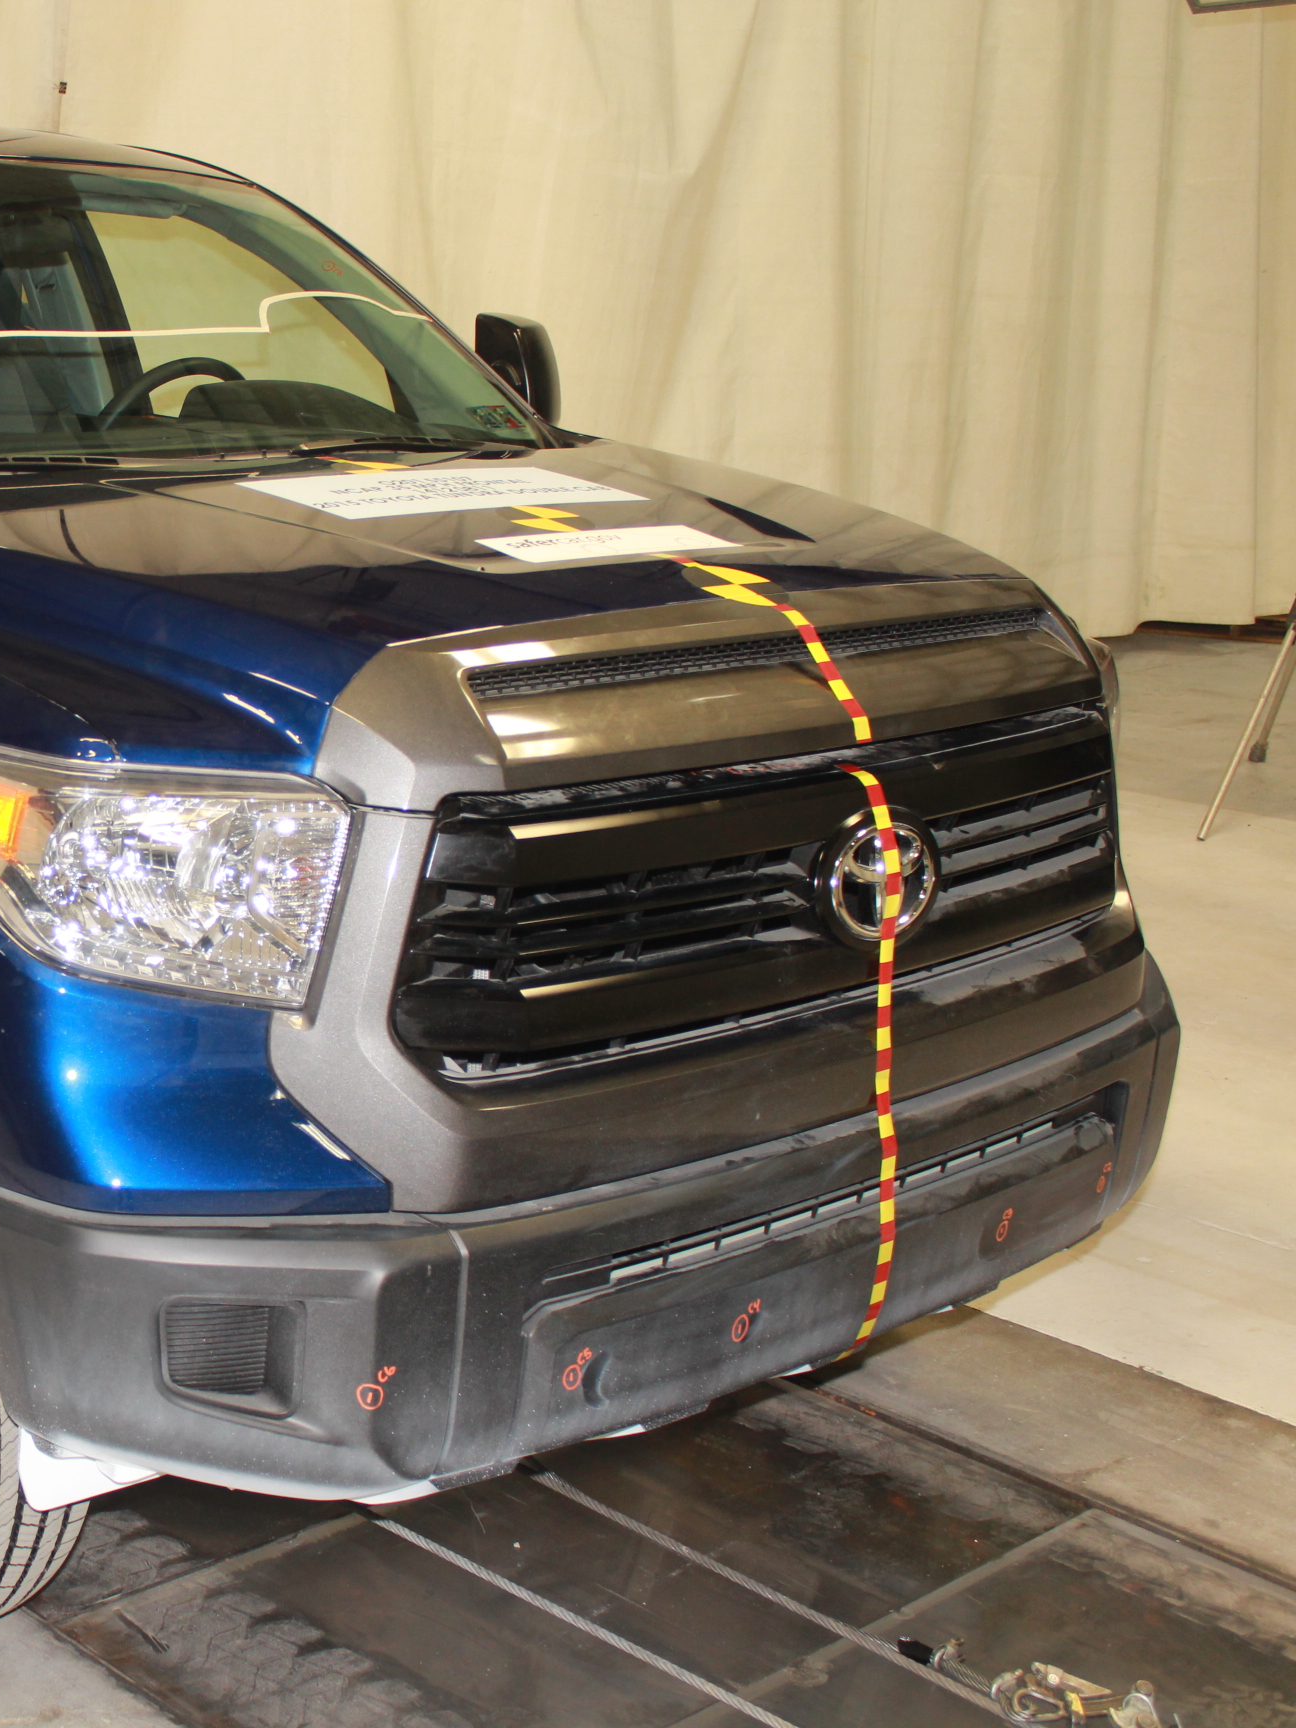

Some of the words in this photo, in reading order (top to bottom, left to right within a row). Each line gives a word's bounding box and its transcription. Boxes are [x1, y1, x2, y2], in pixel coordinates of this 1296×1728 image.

[313, 500, 360, 508] 2015
[358, 495, 437, 504] TOYOTA
[506, 534, 622, 549] safercar.gov
[747, 1298, 761, 1314] C4
[577, 1346, 593, 1366] C5
[377, 1365, 397, 1383] C6
